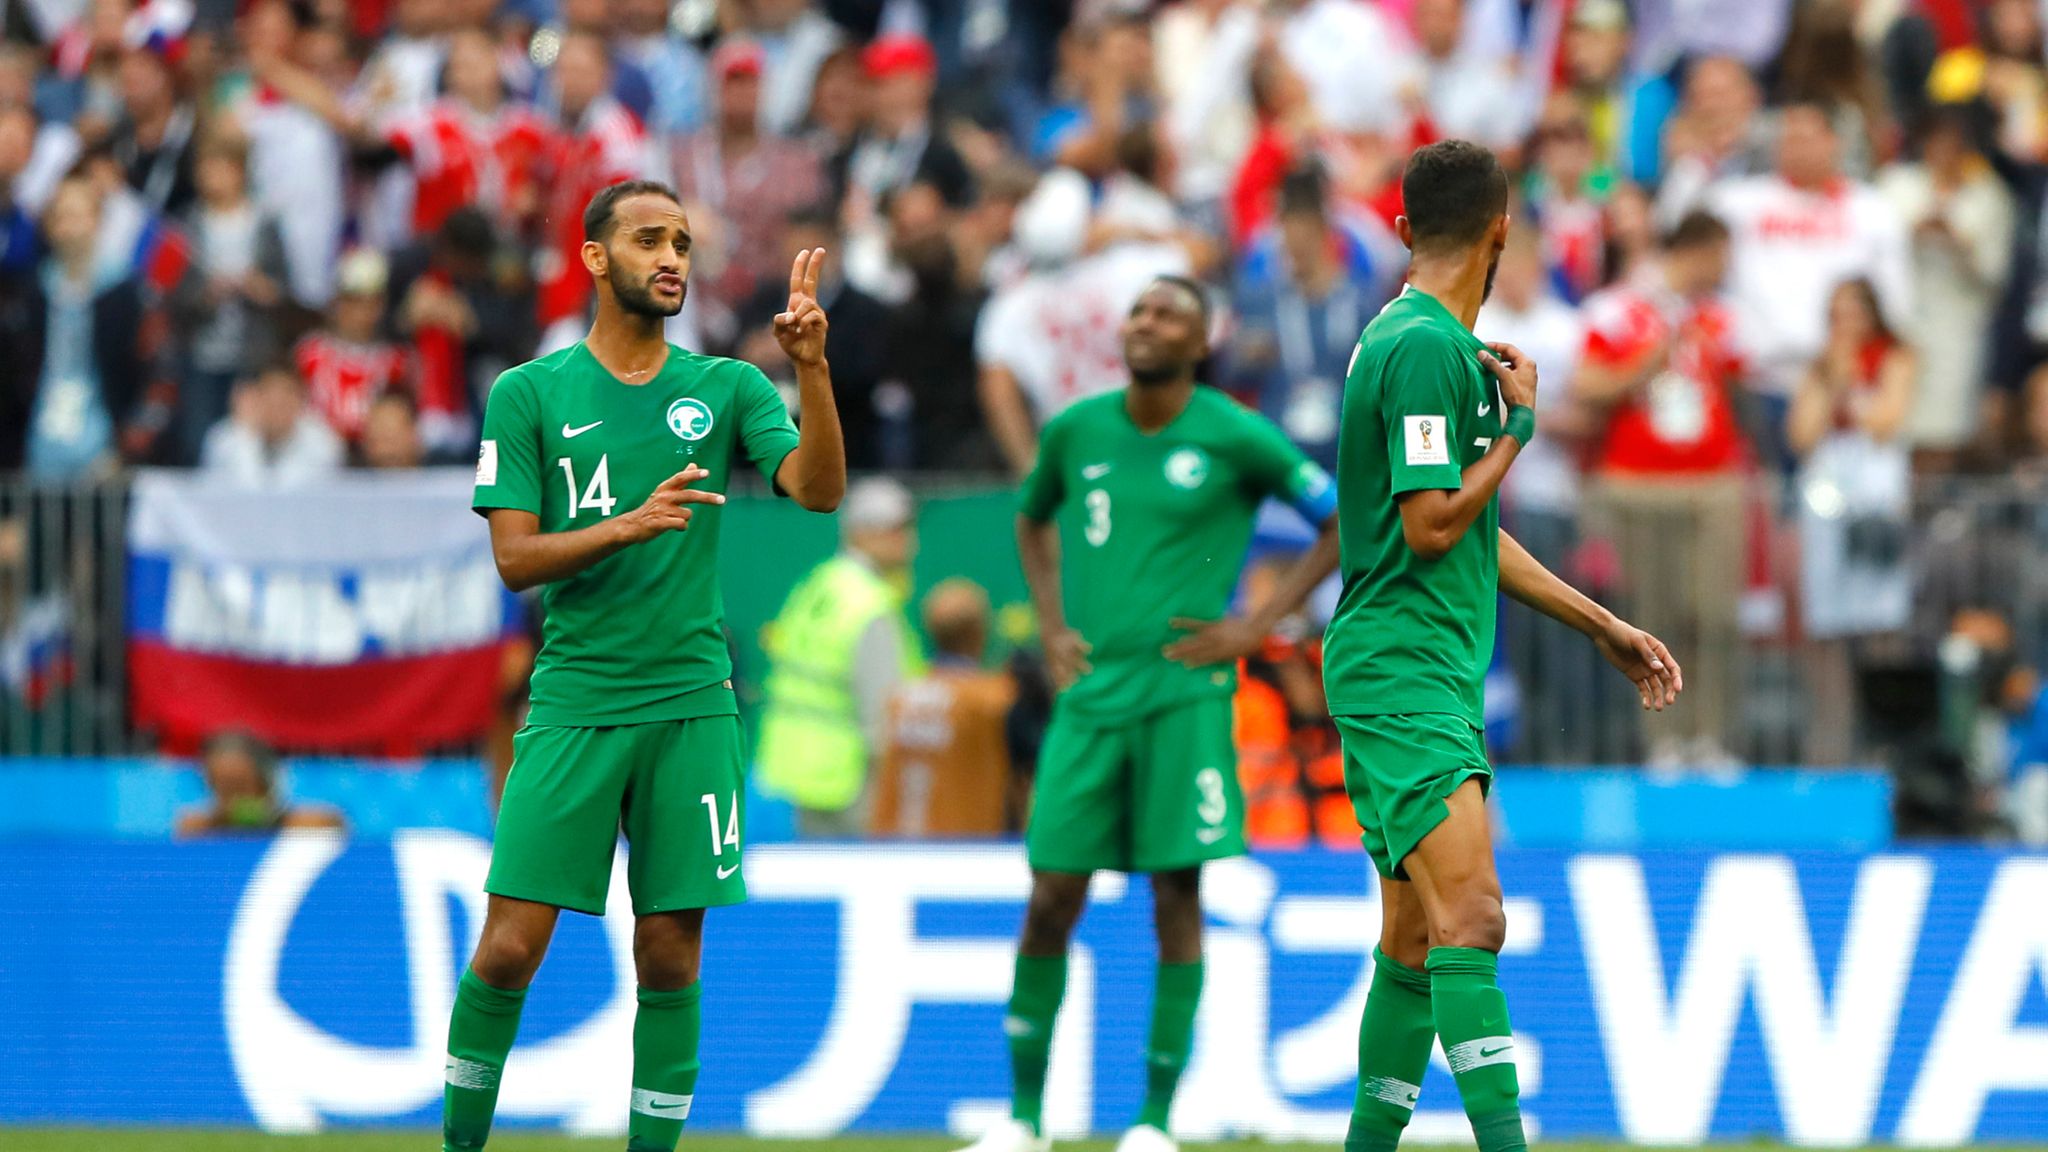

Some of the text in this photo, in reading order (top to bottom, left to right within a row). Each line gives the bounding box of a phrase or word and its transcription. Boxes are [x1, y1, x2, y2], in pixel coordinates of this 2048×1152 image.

[558, 453, 617, 519] 14
[1085, 488, 1112, 547] 3
[701, 789, 740, 856] 14
[1196, 767, 1227, 825] 3
